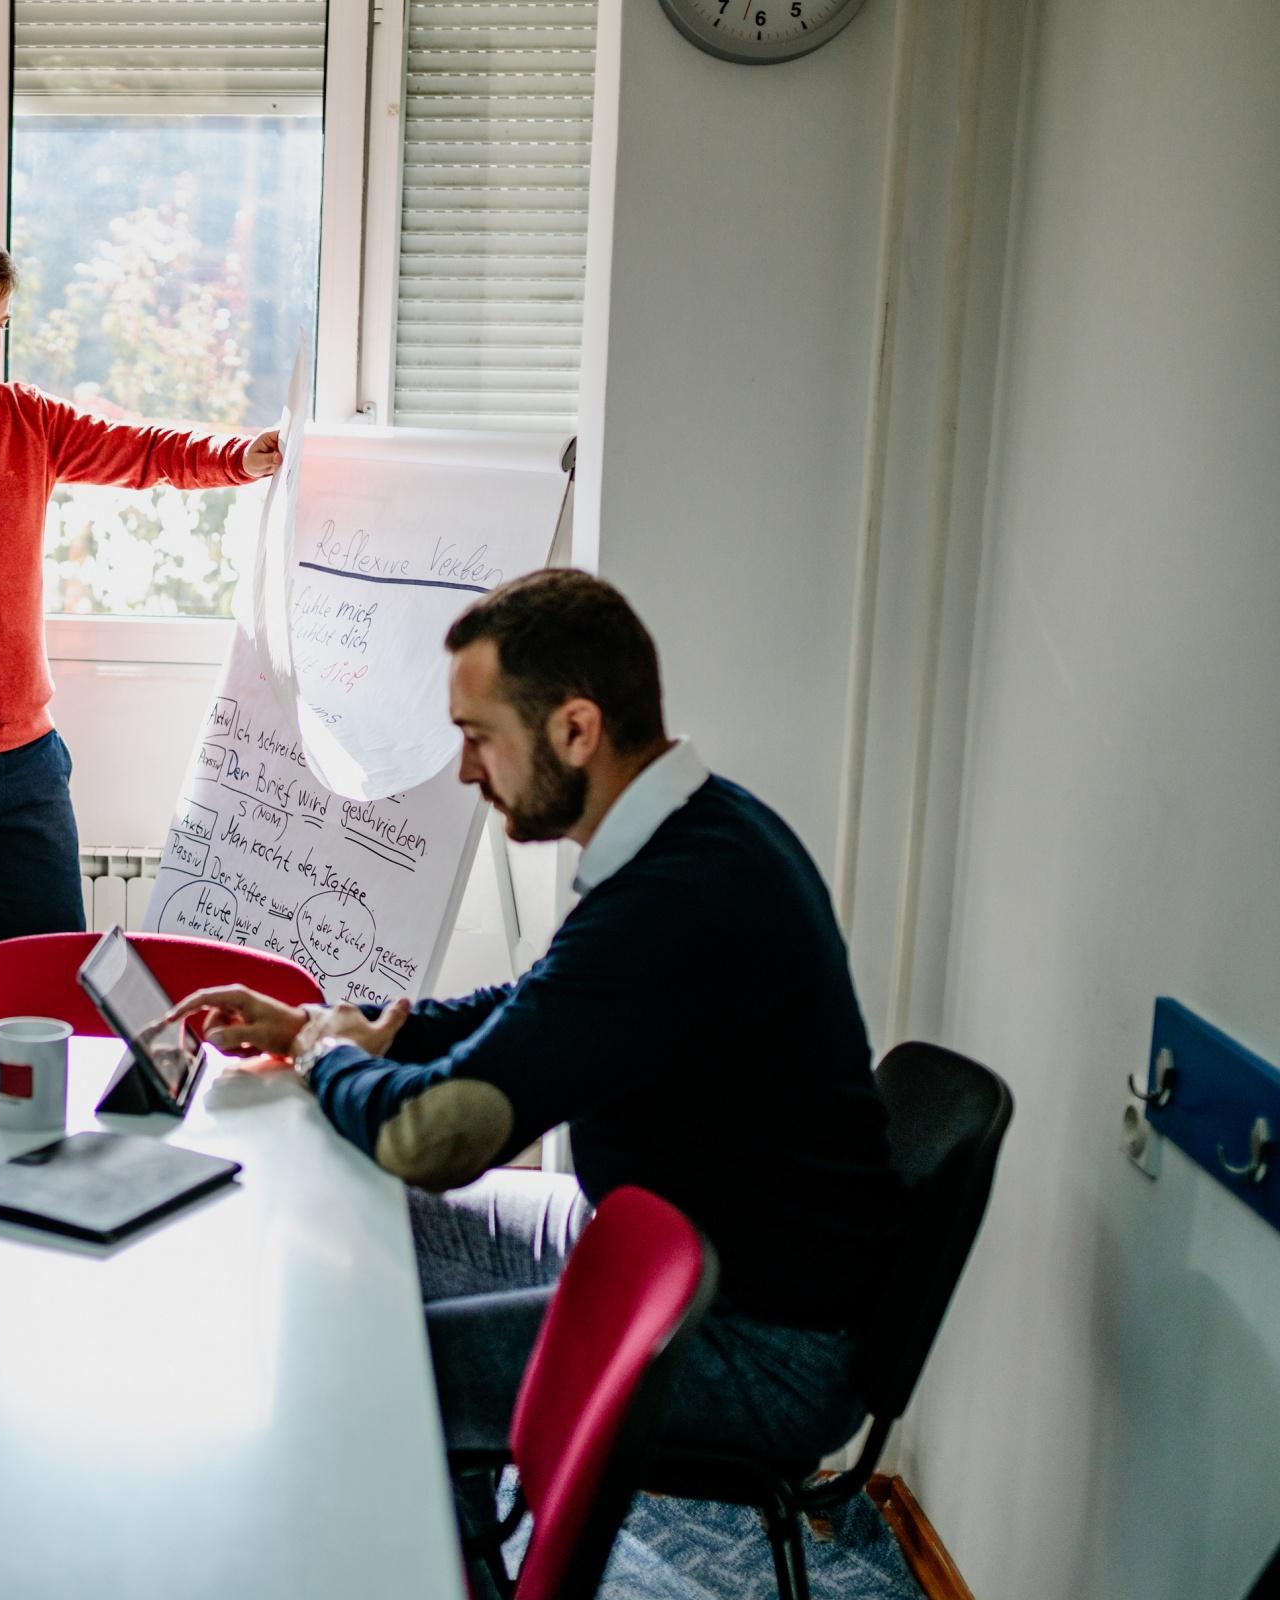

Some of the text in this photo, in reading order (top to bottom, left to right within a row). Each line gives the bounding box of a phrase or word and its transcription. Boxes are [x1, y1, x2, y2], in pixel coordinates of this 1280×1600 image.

[717, 0, 729, 14] 7
[755, 11, 766, 26] 6
[790, 2, 802, 17] 5
[315, 519, 409, 575] Reflexive
[336, 600, 379, 628] mich
[340, 625, 370, 654] dich
[233, 709, 252, 744] Ich
[226, 749, 250, 780] Der
[255, 762, 298, 808] Brief
[182, 814, 210, 839] Aktiv
[220, 815, 248, 849] Man
[298, 846, 317, 887] den
[170, 833, 202, 868] Passiv
[211, 856, 232, 883] Der
[233, 873, 268, 907] Kaffee
[271, 899, 298, 920] wird
[302, 906, 312, 925] in
[316, 914, 333, 934] der
[196, 887, 232, 925] Heute
[236, 915, 262, 935] wird
[310, 931, 340, 960] heute
